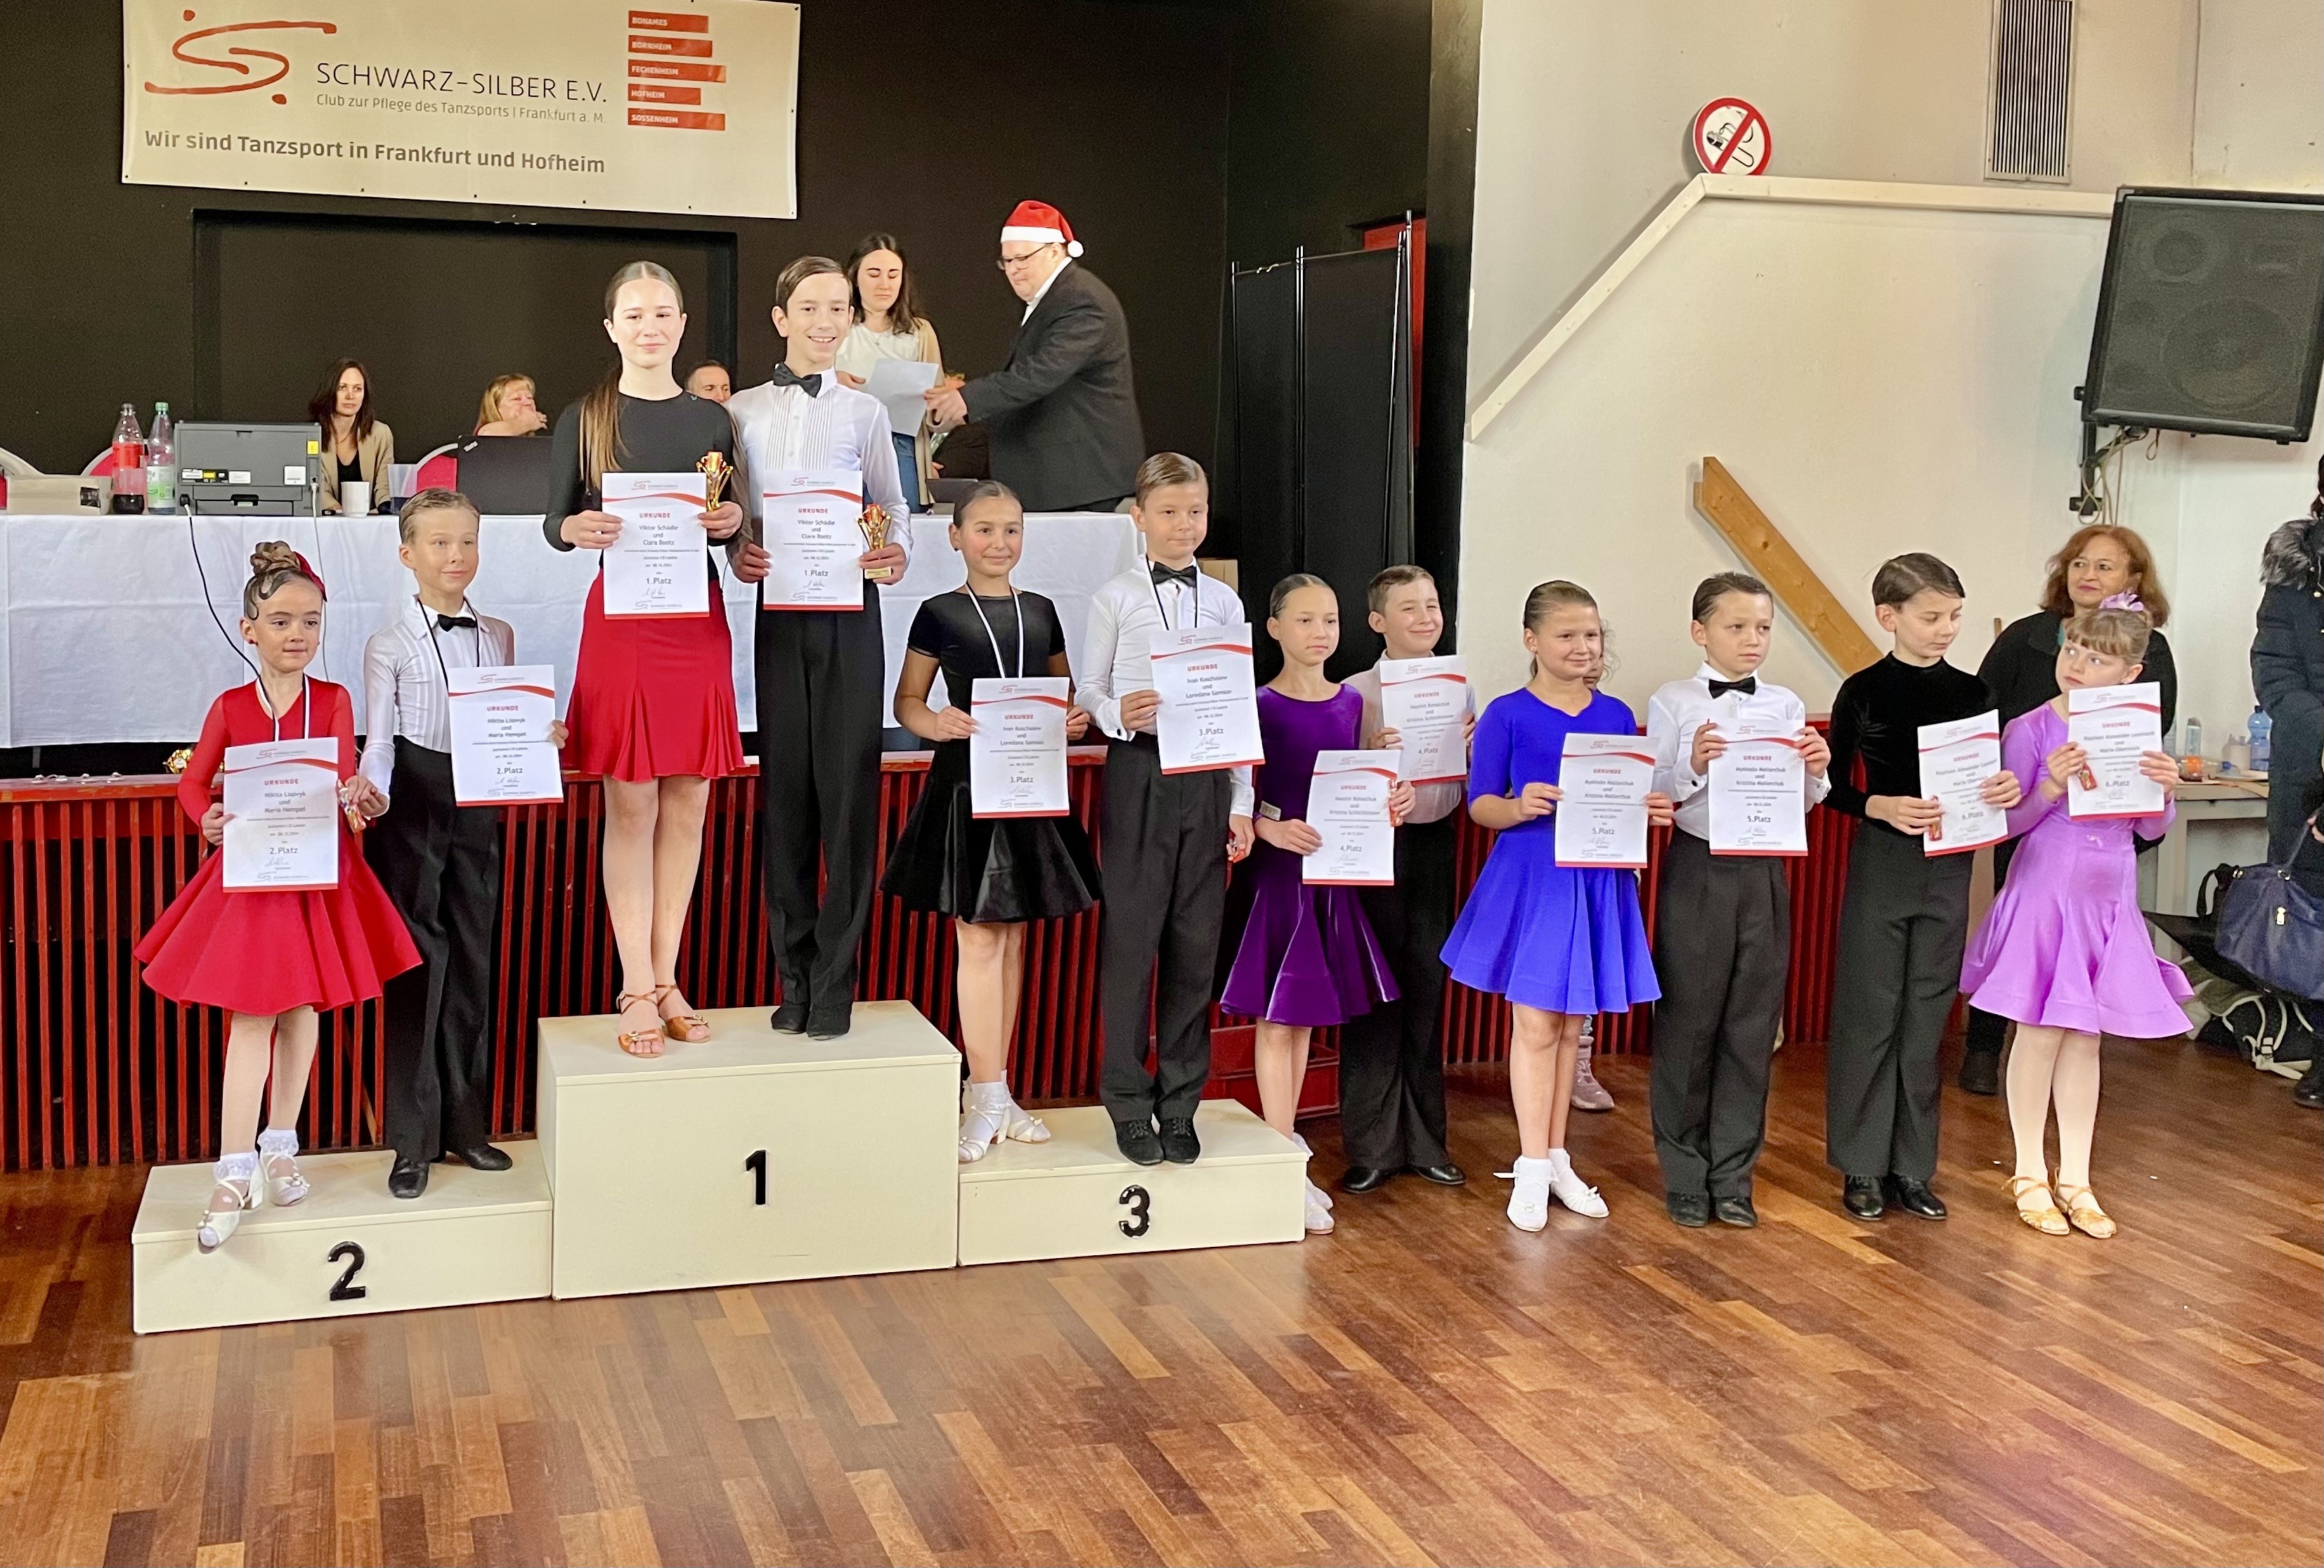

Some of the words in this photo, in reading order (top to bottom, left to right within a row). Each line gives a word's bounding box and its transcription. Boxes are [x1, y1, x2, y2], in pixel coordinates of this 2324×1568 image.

[632, 17, 668, 26] BONAMES
[632, 41, 673, 51] BORNHEIM
[317, 63, 557, 98] SCHWARZ-SILBER
[566, 80, 606, 103] E.V.
[631, 65, 679, 75] FECHENHEIM
[317, 93, 345, 107] Club
[349, 97, 369, 108] zur
[372, 97, 412, 112] Pflege
[415, 100, 438, 112] des
[441, 102, 509, 117] Tanzsports
[519, 108, 576, 122] Frankfurt
[579, 113, 590, 122] a.
[631, 90, 666, 99] HOFHEIM
[631, 114, 679, 124] SOSSENHEIM
[145, 130, 180, 148] Wir
[186, 132, 232, 150] sind
[237, 136, 343, 159] Tanzsport
[349, 141, 368, 159] in
[375, 143, 472, 164] Frankfurt
[477, 151, 514, 167] und
[521, 153, 605, 173] Hofheim
[746, 1150, 765, 1205] 1
[1119, 1184, 1150, 1238] 3
[327, 1241, 365, 1301] 2
